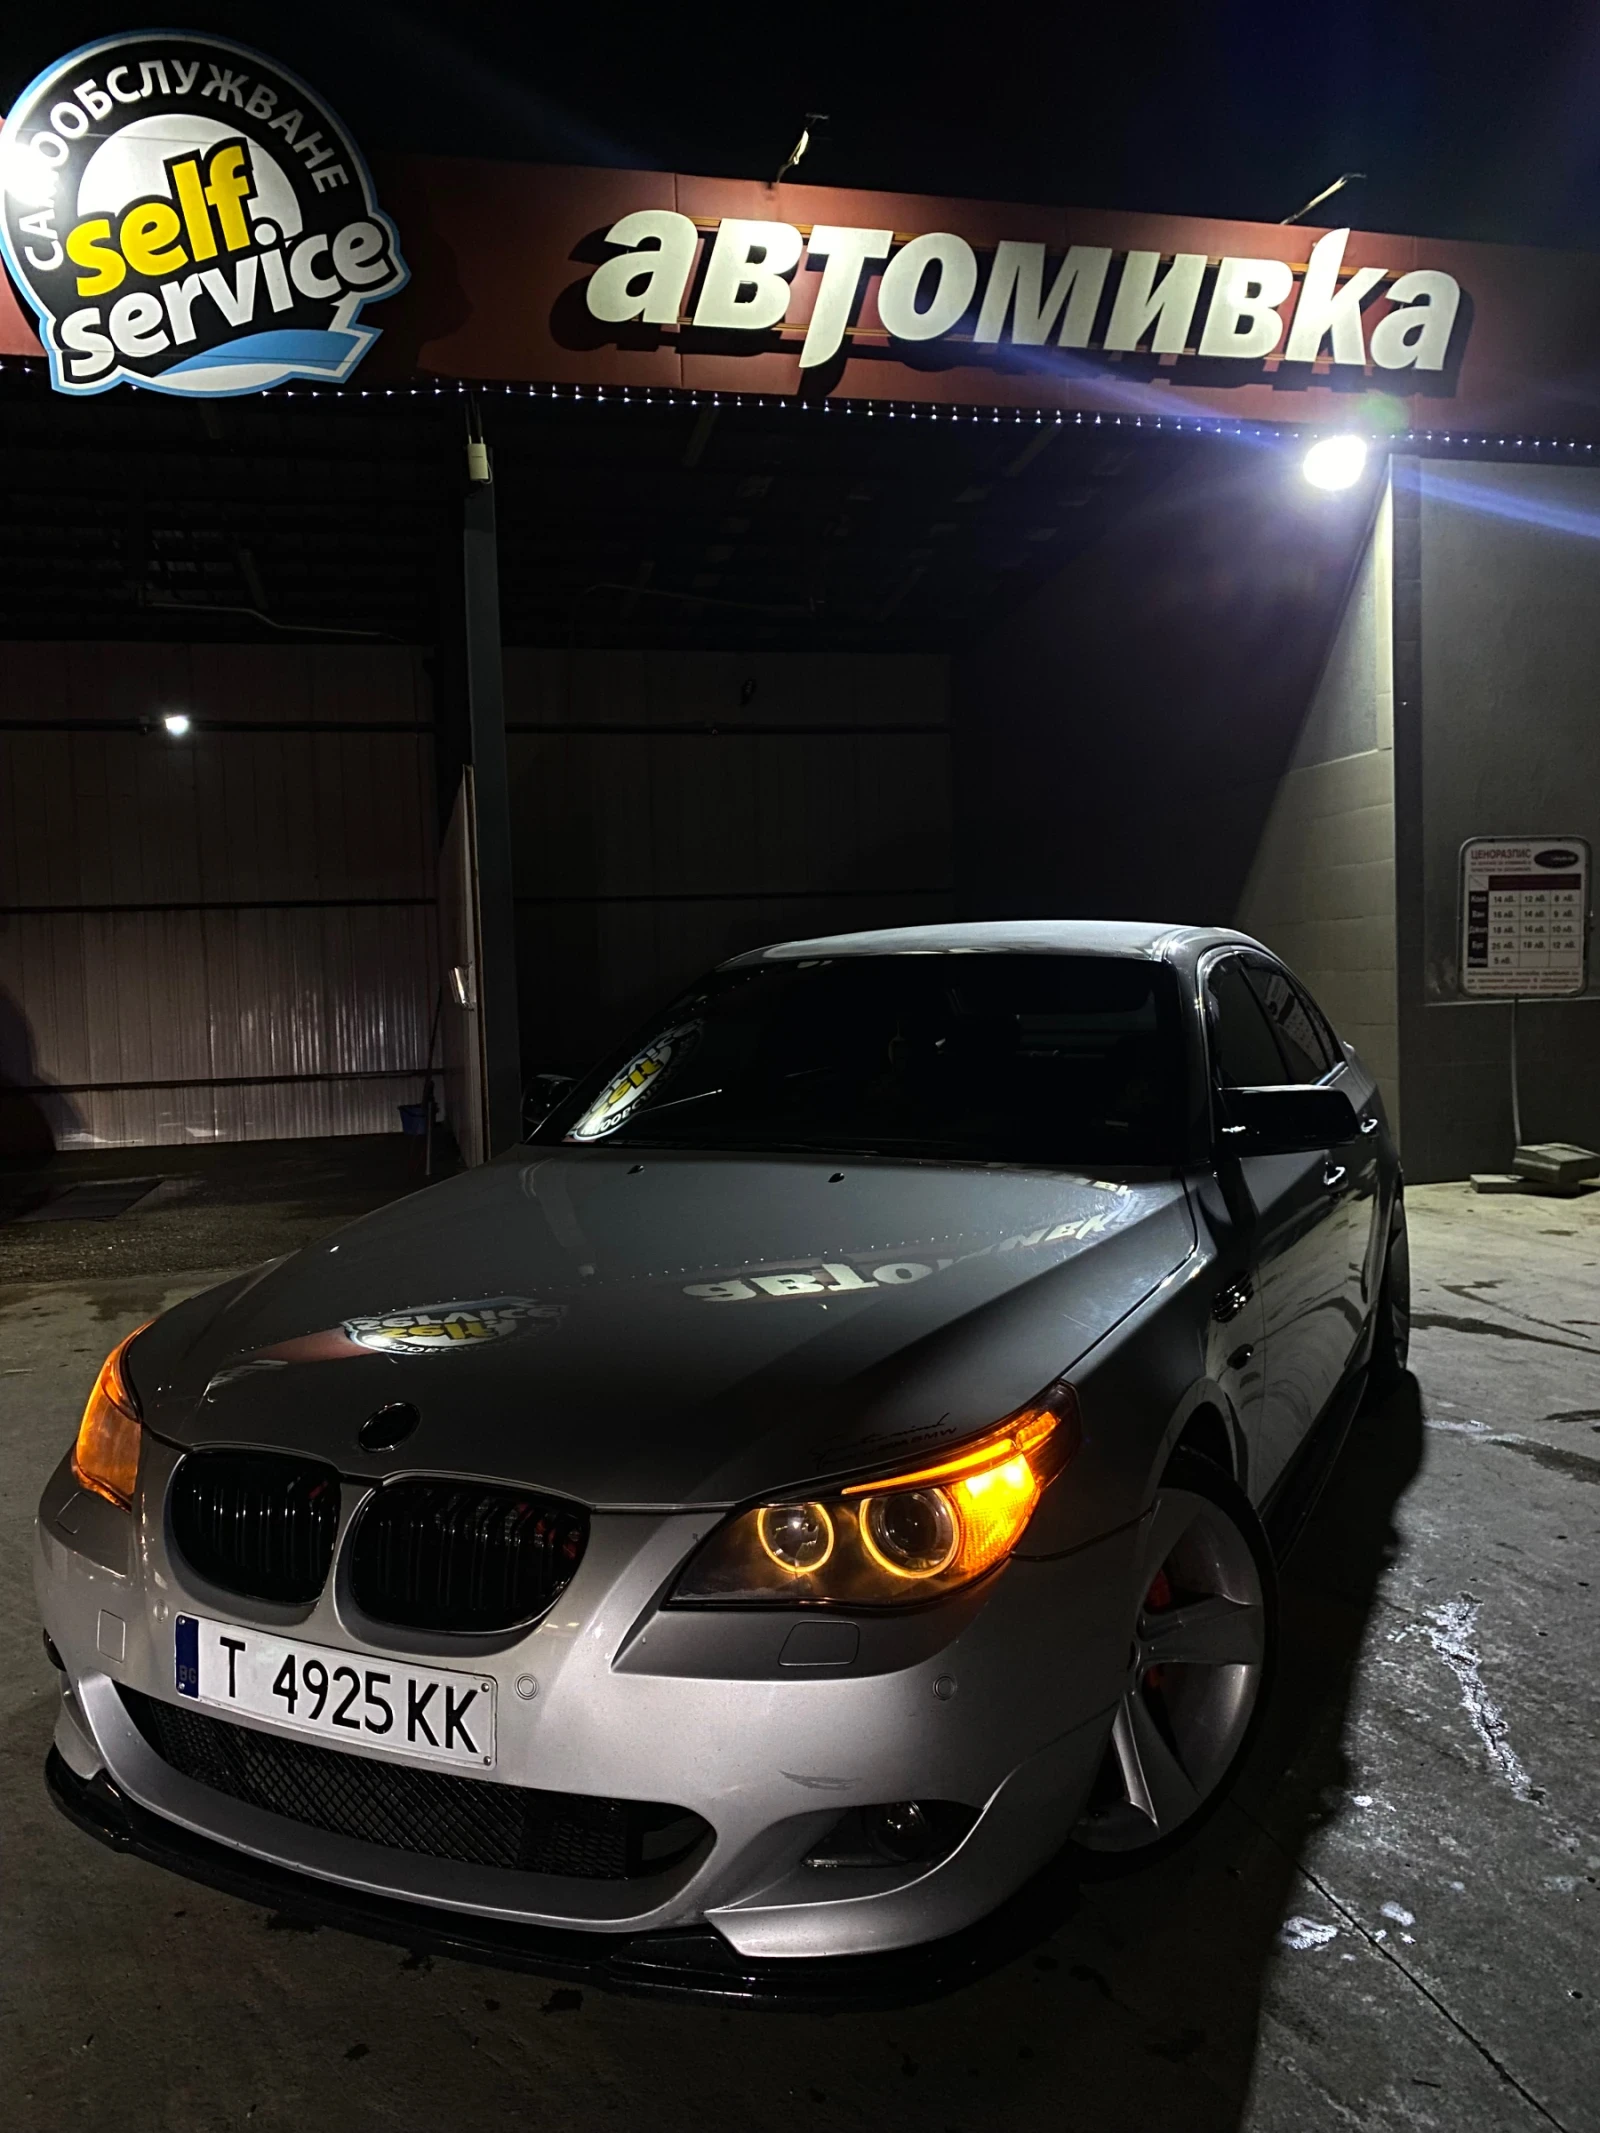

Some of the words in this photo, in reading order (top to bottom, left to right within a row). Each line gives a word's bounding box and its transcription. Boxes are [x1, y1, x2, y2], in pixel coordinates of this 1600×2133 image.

[20, 60, 349, 271] САООБСЛУЖВАНЕ
[66, 145, 250, 296] self
[61, 222, 388, 377] service
[586, 209, 1461, 368] автомивка
[1471, 849, 1531, 860] ЦЕНОРАЗПИС
[179, 1664, 197, 1684] BG
[220, 1636, 246, 1698] T
[273, 1654, 394, 1735] 4925
[407, 1679, 480, 1754] KK
